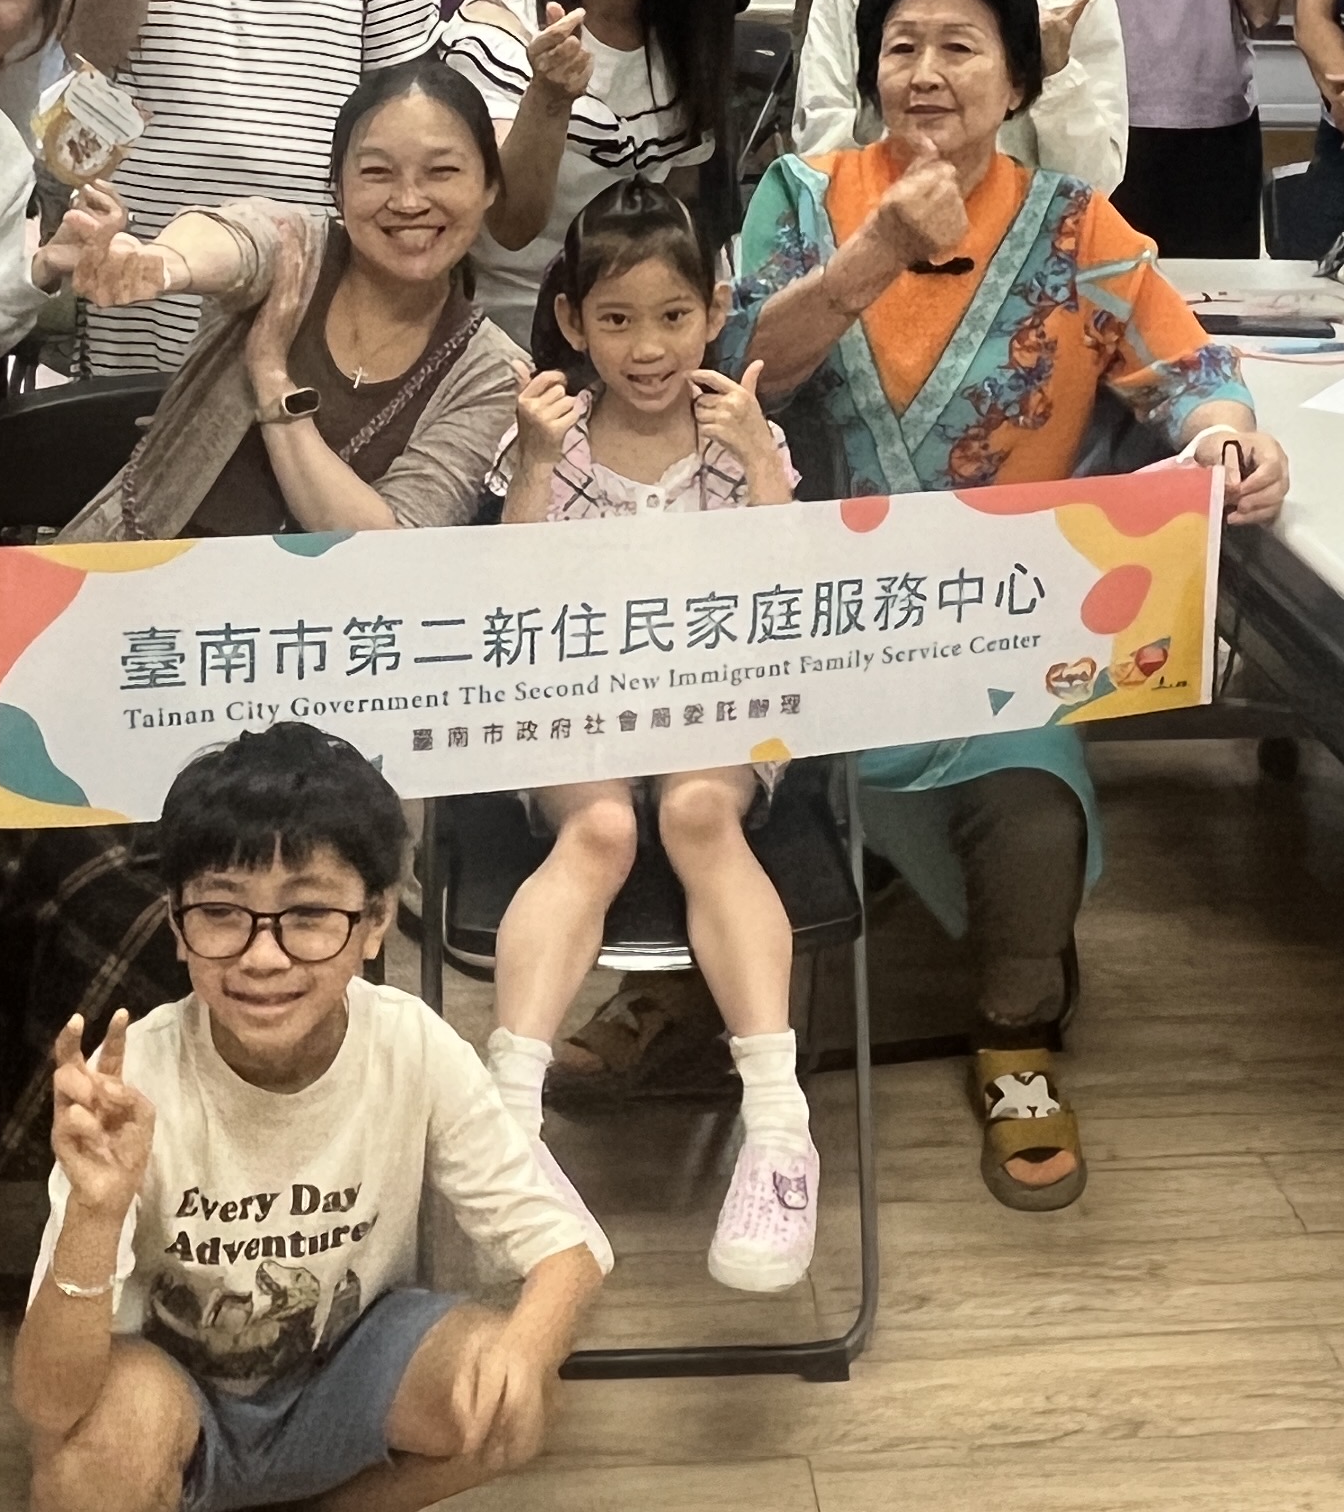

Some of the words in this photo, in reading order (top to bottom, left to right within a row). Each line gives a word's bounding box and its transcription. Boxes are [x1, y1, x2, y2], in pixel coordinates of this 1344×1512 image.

[119, 562, 1046, 691] 臺南市第二新住民家庭服務中心
[123, 703, 215, 730] Tainan
[226, 699, 281, 726] City
[291, 690, 450, 719] Government
[459, 685, 506, 706] The
[514, 675, 600, 702] Second
[610, 670, 660, 694] New
[669, 660, 792, 691] Immigrant
[799, 649, 875, 676] Family
[881, 641, 963, 665] Service
[969, 631, 1042, 655] Center
[164, 1210, 380, 1265] Adventure
[175, 1185, 282, 1223] Every
[289, 1181, 363, 1216] Day
